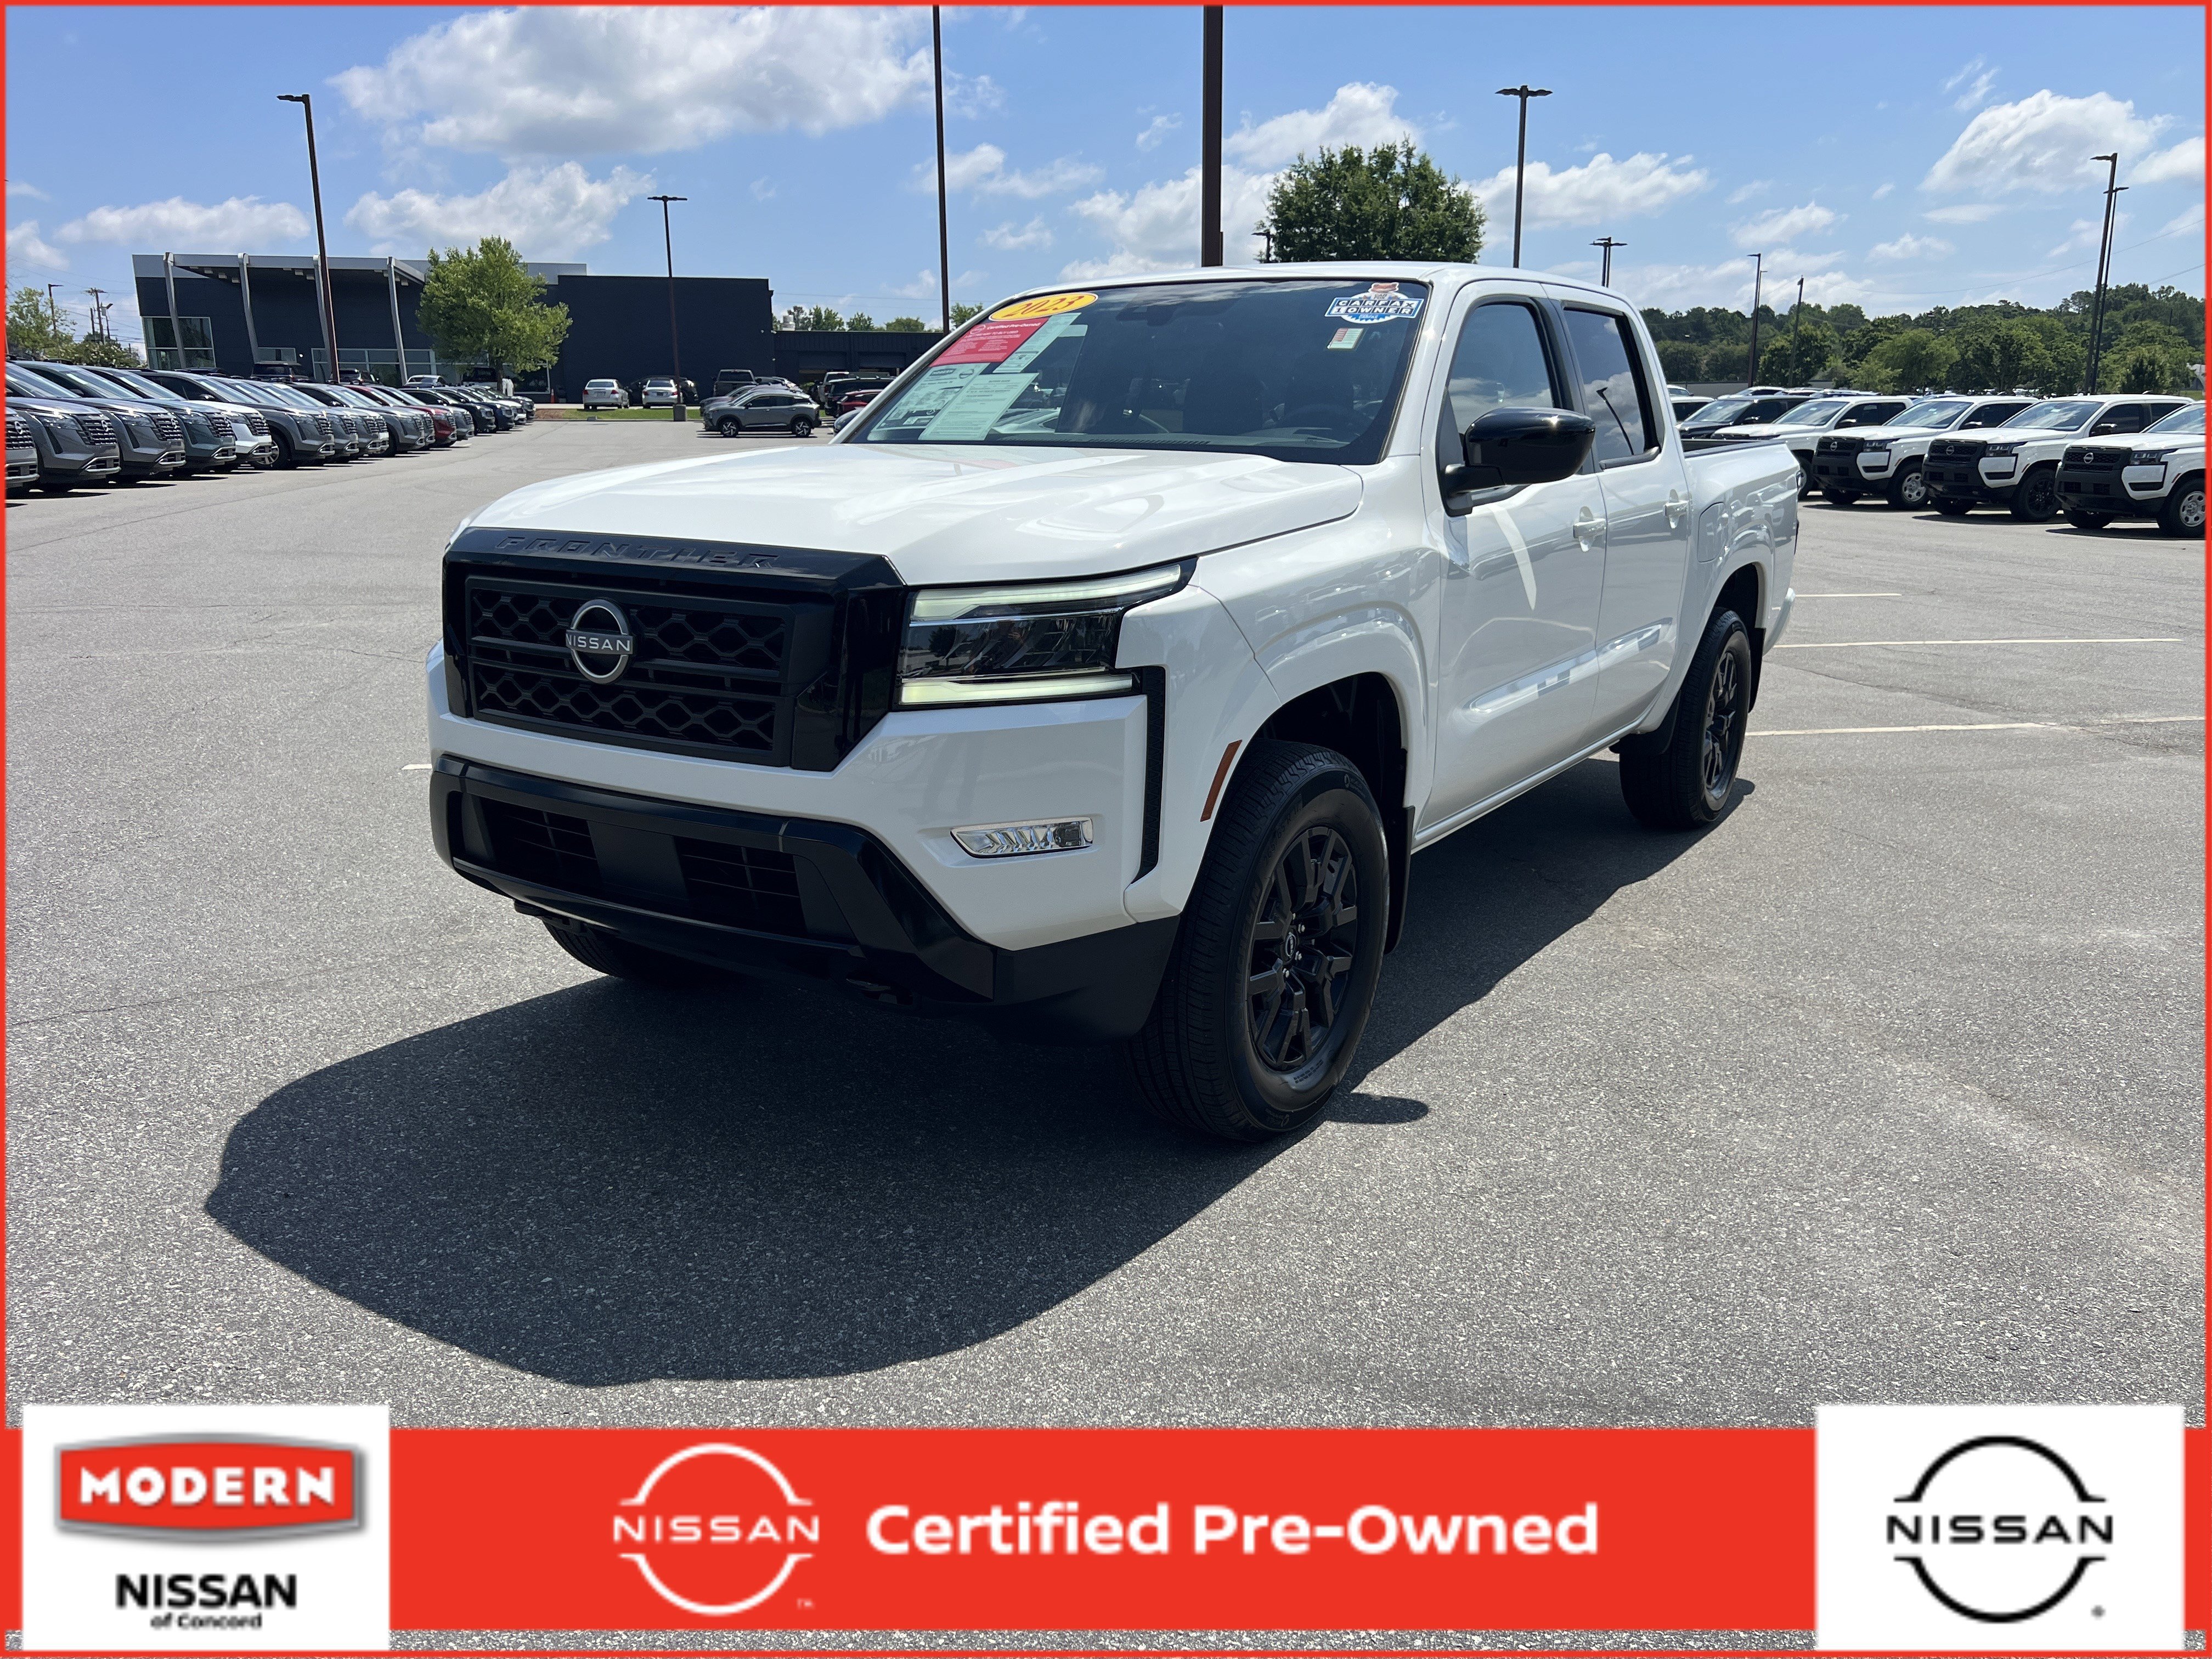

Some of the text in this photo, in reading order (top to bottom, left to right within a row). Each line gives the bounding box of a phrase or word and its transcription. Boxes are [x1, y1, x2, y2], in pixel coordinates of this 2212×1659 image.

[1001, 295, 1085, 318] 2023
[1338, 300, 1414, 308] CARFAX
[1347, 307, 1412, 315] OWNER
[495, 536, 780, 568] FRONTIER
[565, 633, 630, 652] NISSAN
